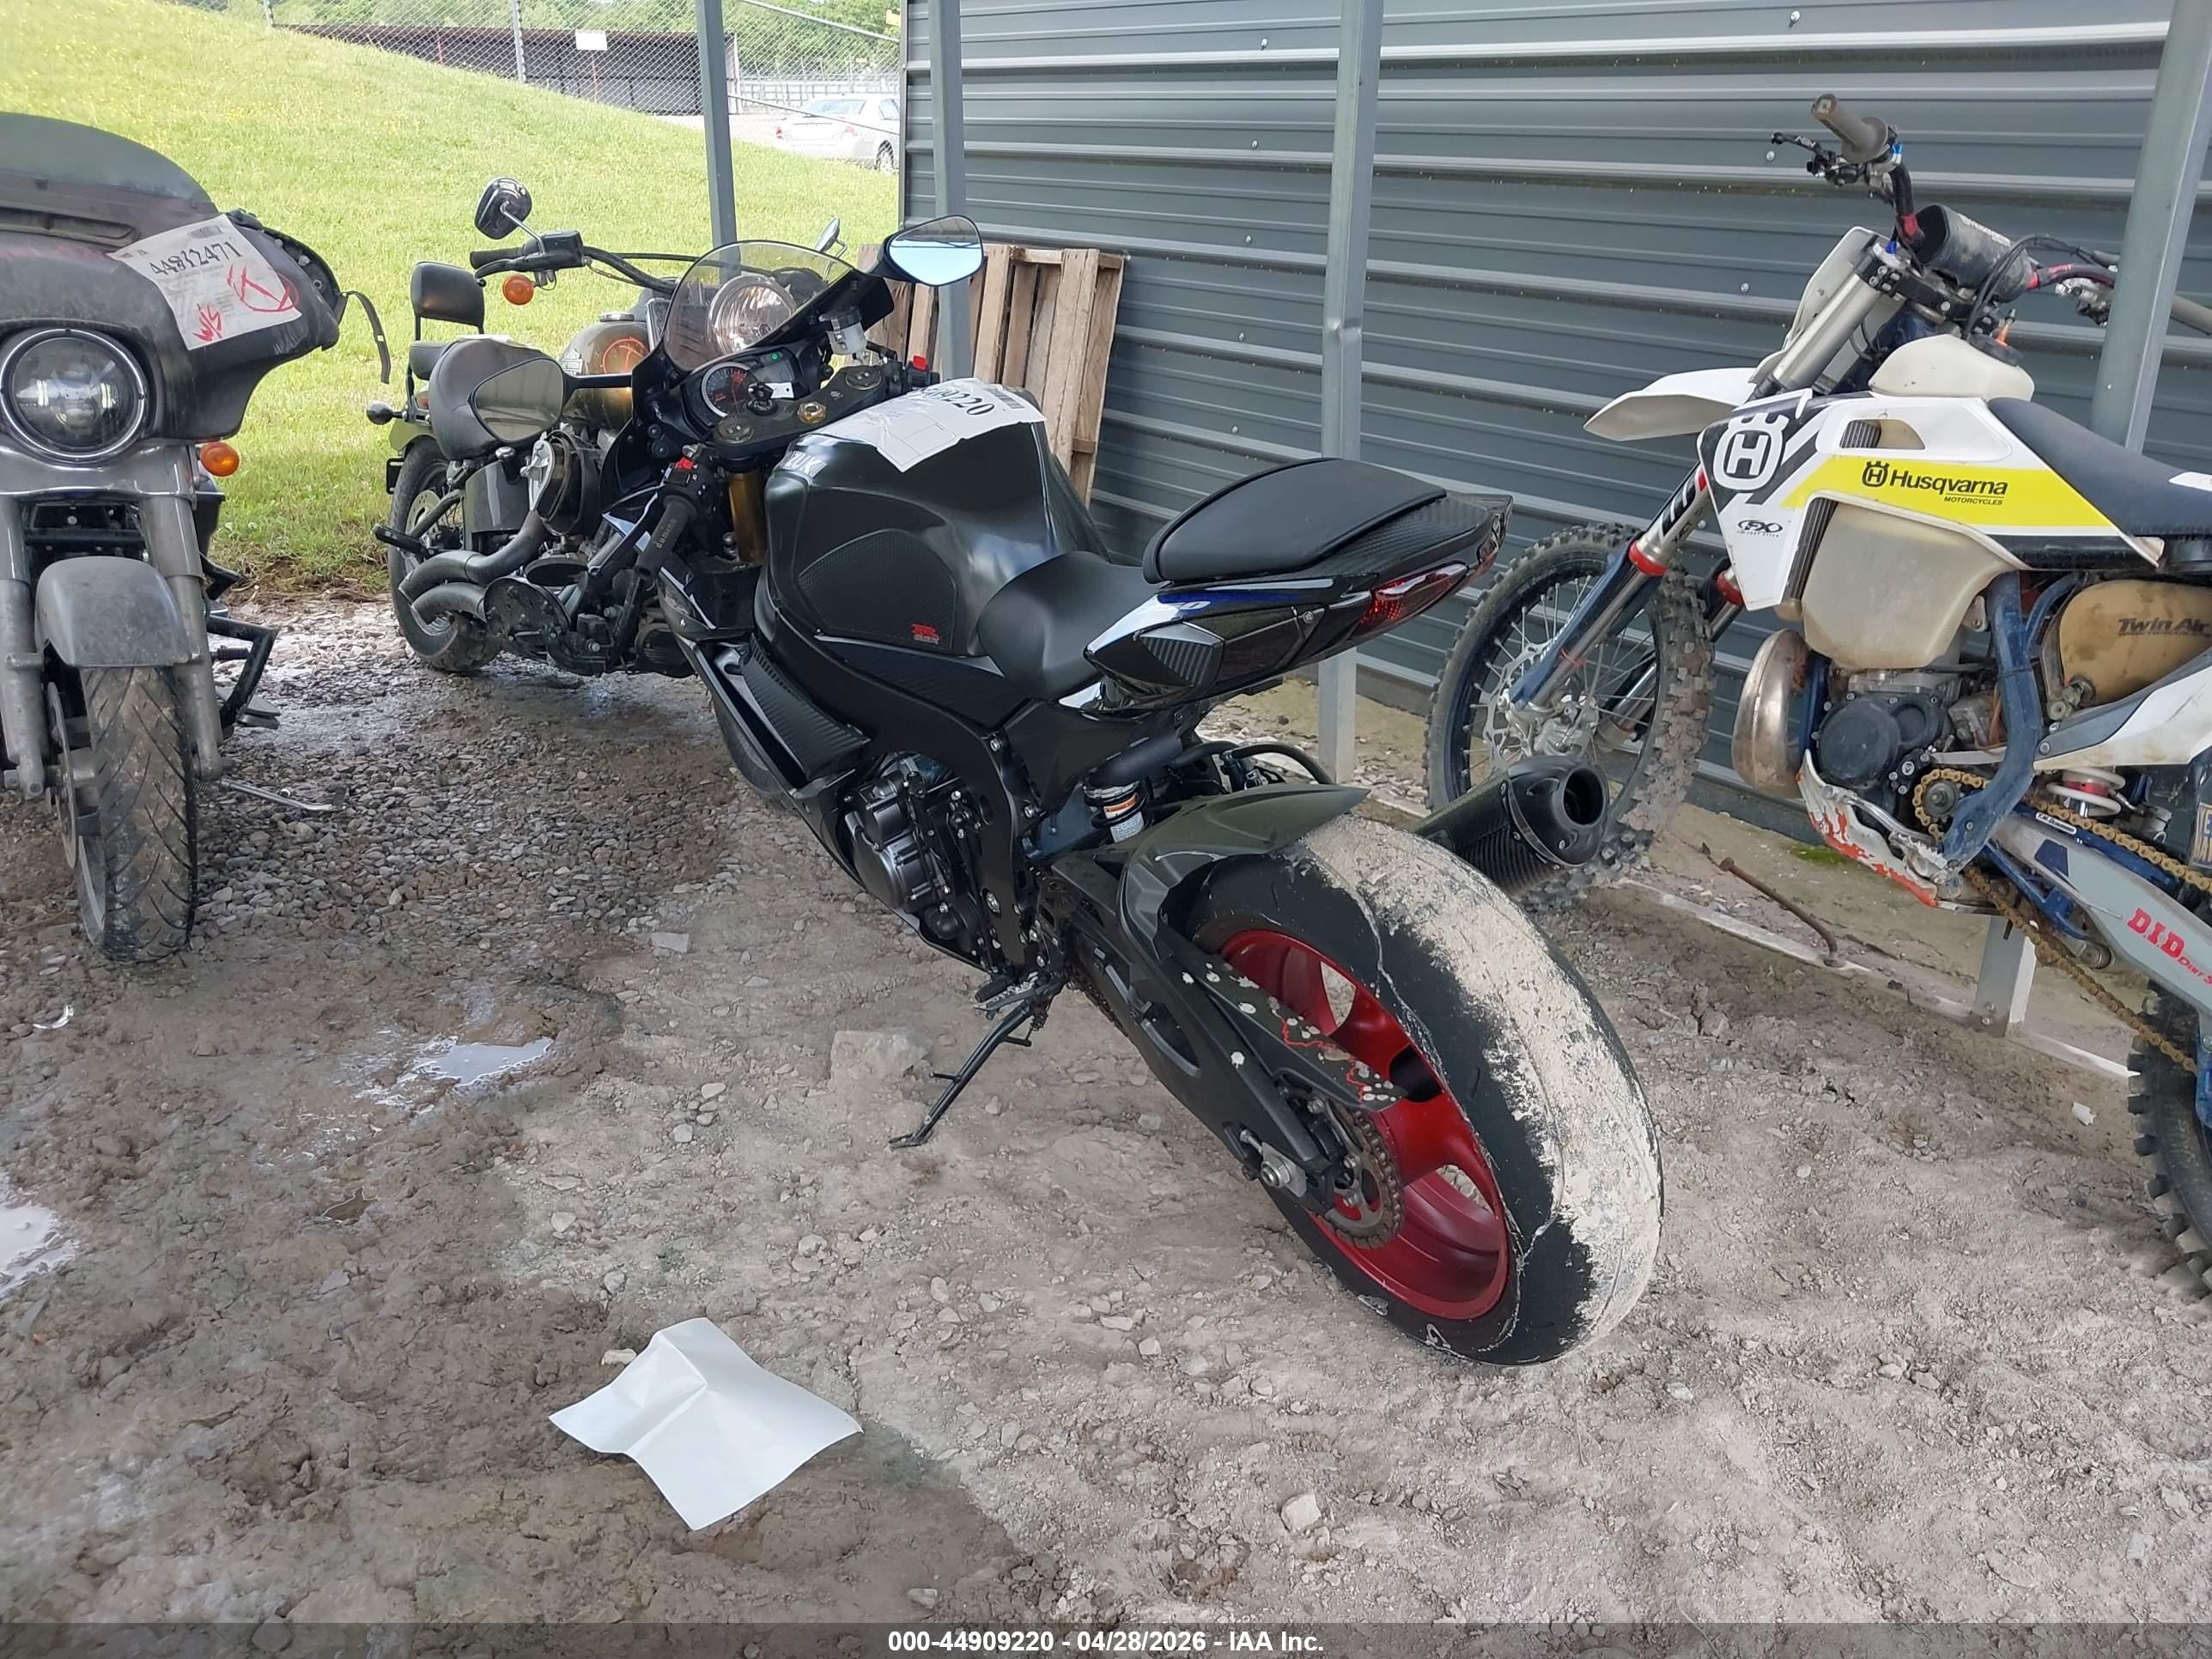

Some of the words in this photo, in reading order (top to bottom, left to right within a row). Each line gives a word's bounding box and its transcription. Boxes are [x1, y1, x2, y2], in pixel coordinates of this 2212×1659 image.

[1889, 469, 2008, 495] Husqvarna
[1943, 496, 2003, 506] MOTORCYCLES
[2118, 617, 2172, 633] Twin
[2174, 617, 2210, 633] Air
